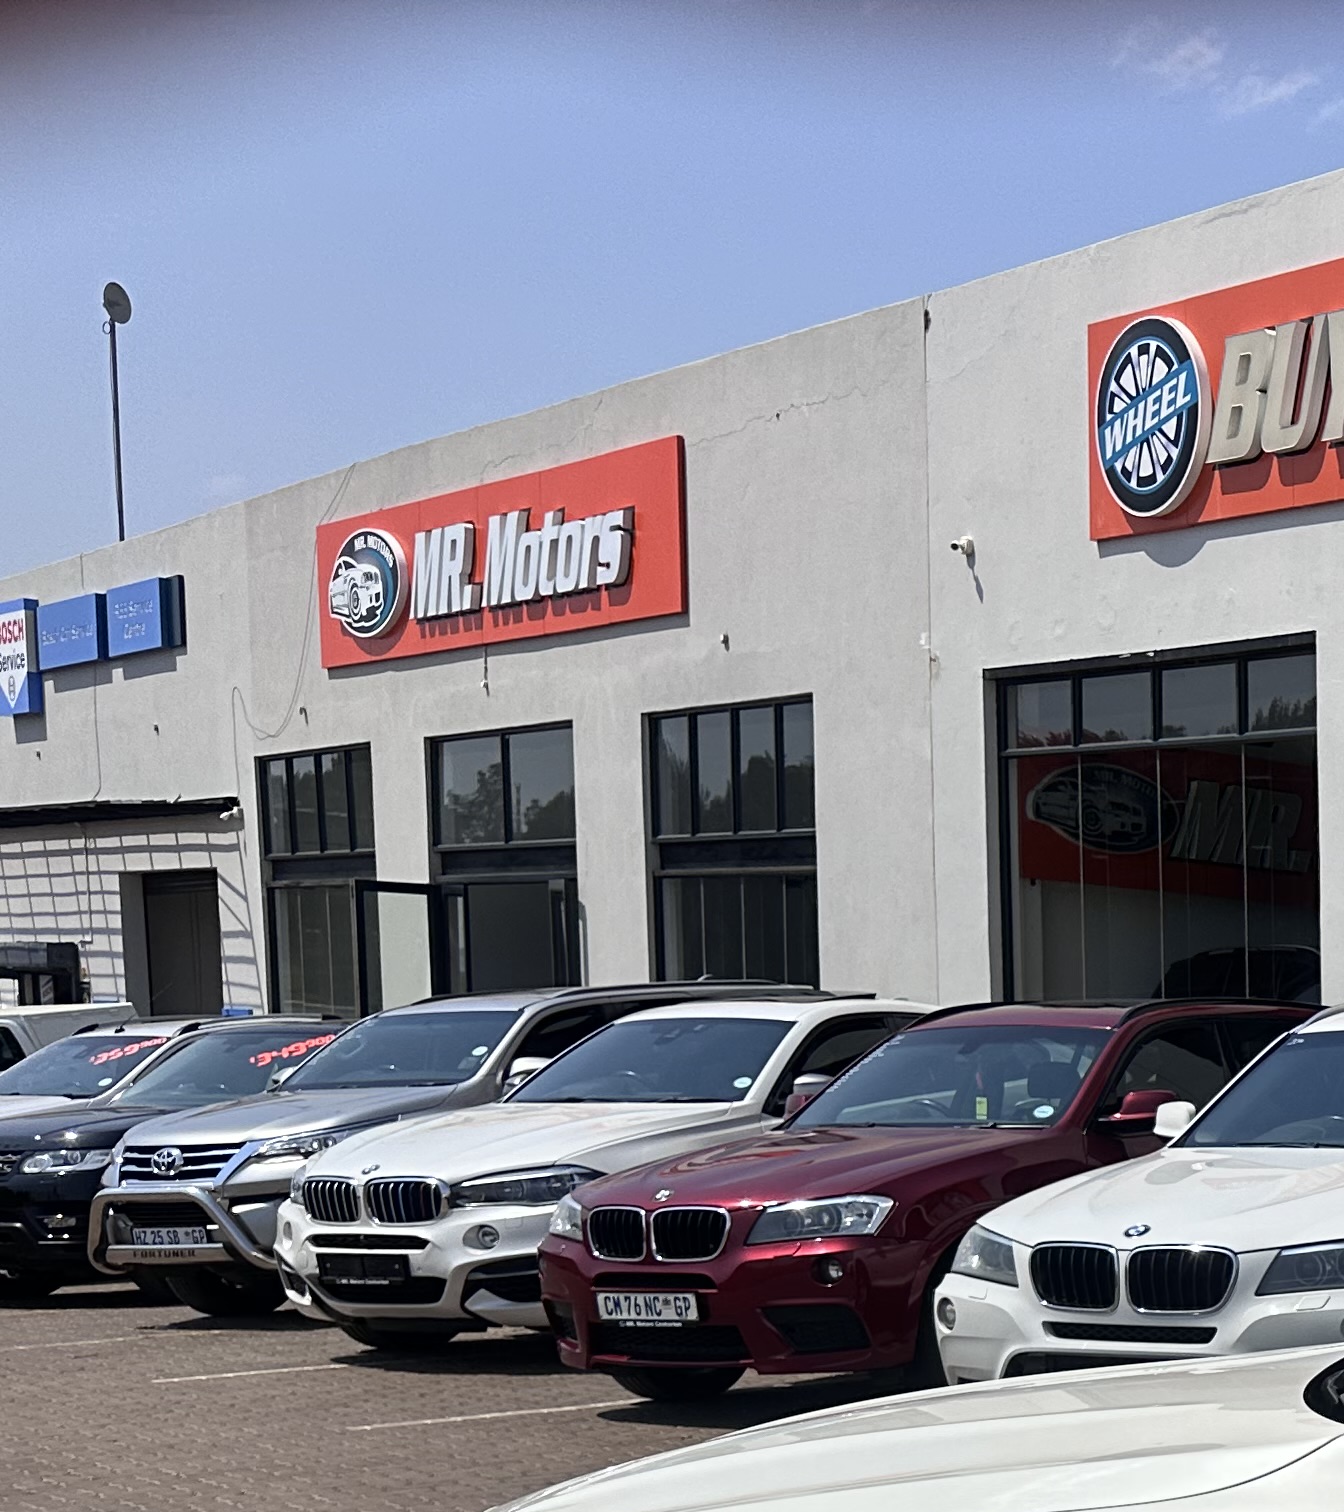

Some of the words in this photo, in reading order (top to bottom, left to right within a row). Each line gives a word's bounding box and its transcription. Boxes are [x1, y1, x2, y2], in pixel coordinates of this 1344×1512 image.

[1103, 370, 1192, 461] WHEEL
[410, 521, 482, 620] MR.
[482, 506, 635, 608] Motors
[0, 618, 24, 645] OSCH
[151, 1230, 164, 1245] 25
[191, 1229, 205, 1244] GP
[674, 1296, 691, 1317] GP
